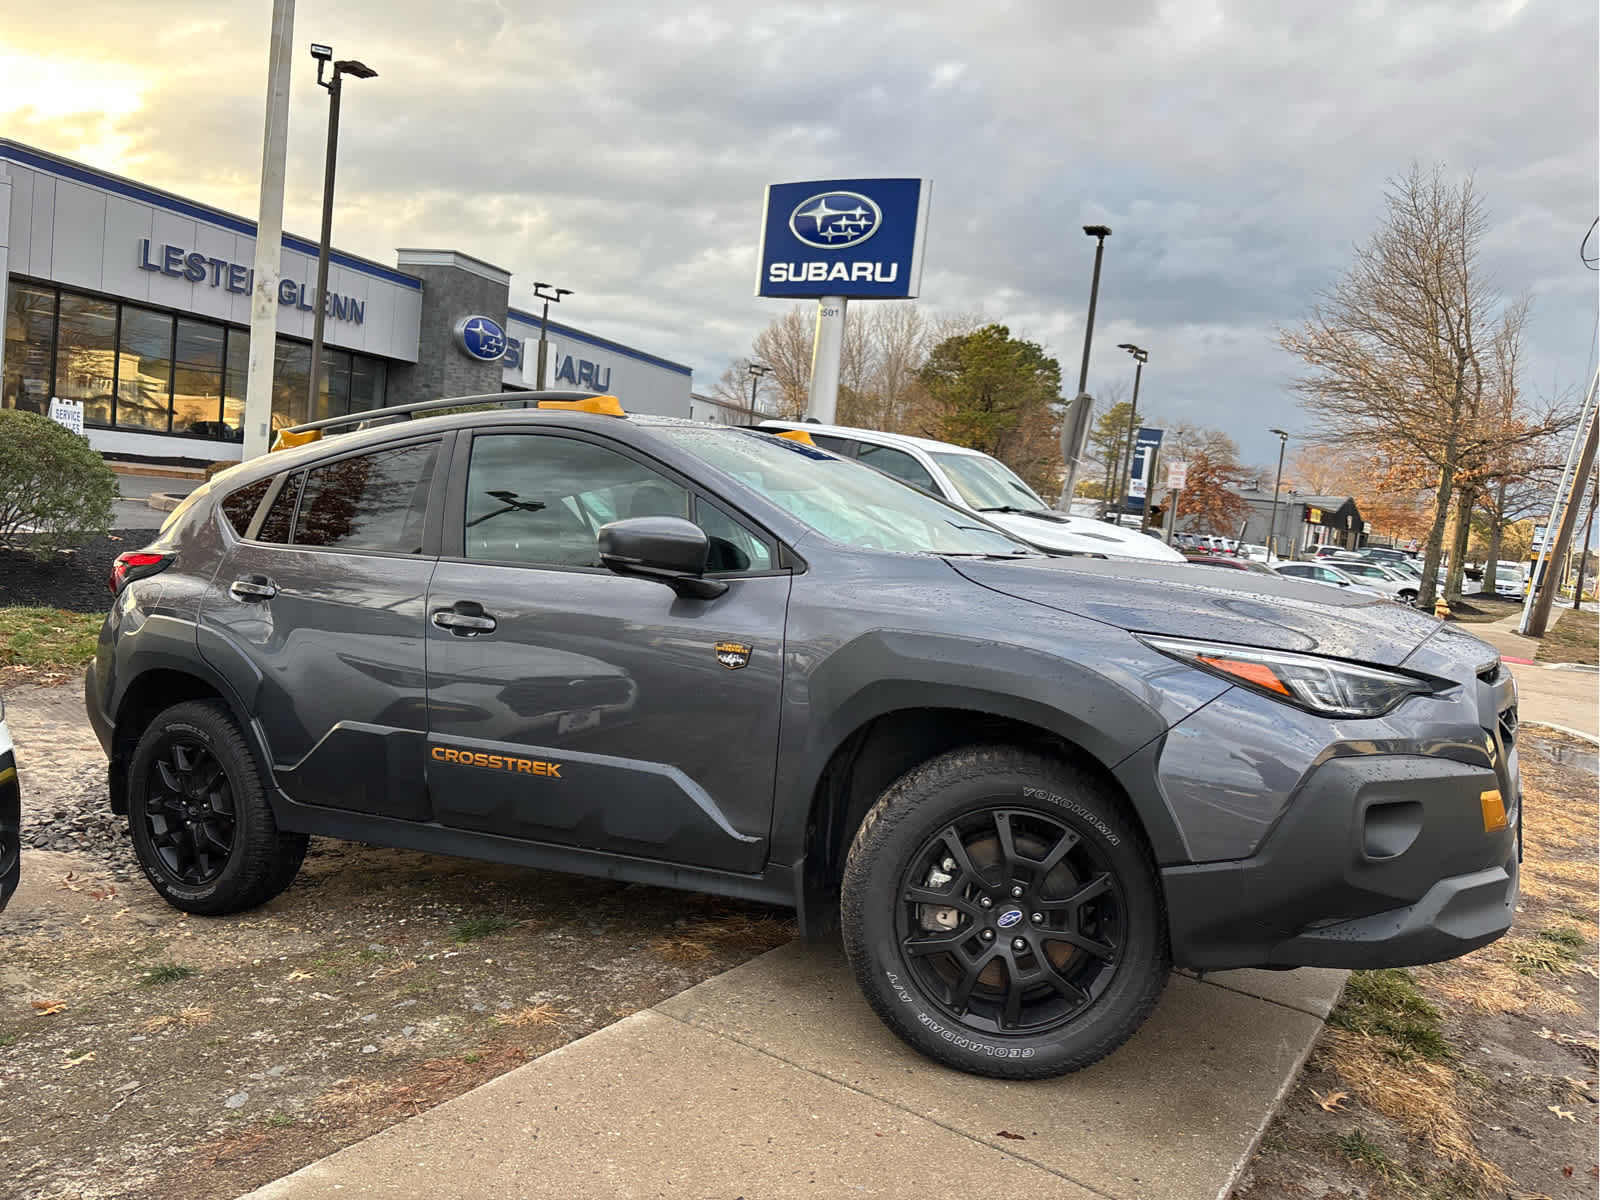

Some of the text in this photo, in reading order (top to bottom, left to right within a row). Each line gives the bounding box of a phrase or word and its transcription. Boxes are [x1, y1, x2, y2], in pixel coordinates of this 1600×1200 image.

[139, 239, 255, 296] LESTE
[769, 262, 898, 282] SUBARU
[503, 337, 611, 392] SARU
[55, 408, 81, 422] SERVICE
[431, 746, 563, 778] CROSSTREK
[1022, 785, 1120, 846] YOKOHAMA
[917, 1011, 1035, 1058] GEOLANDAR
